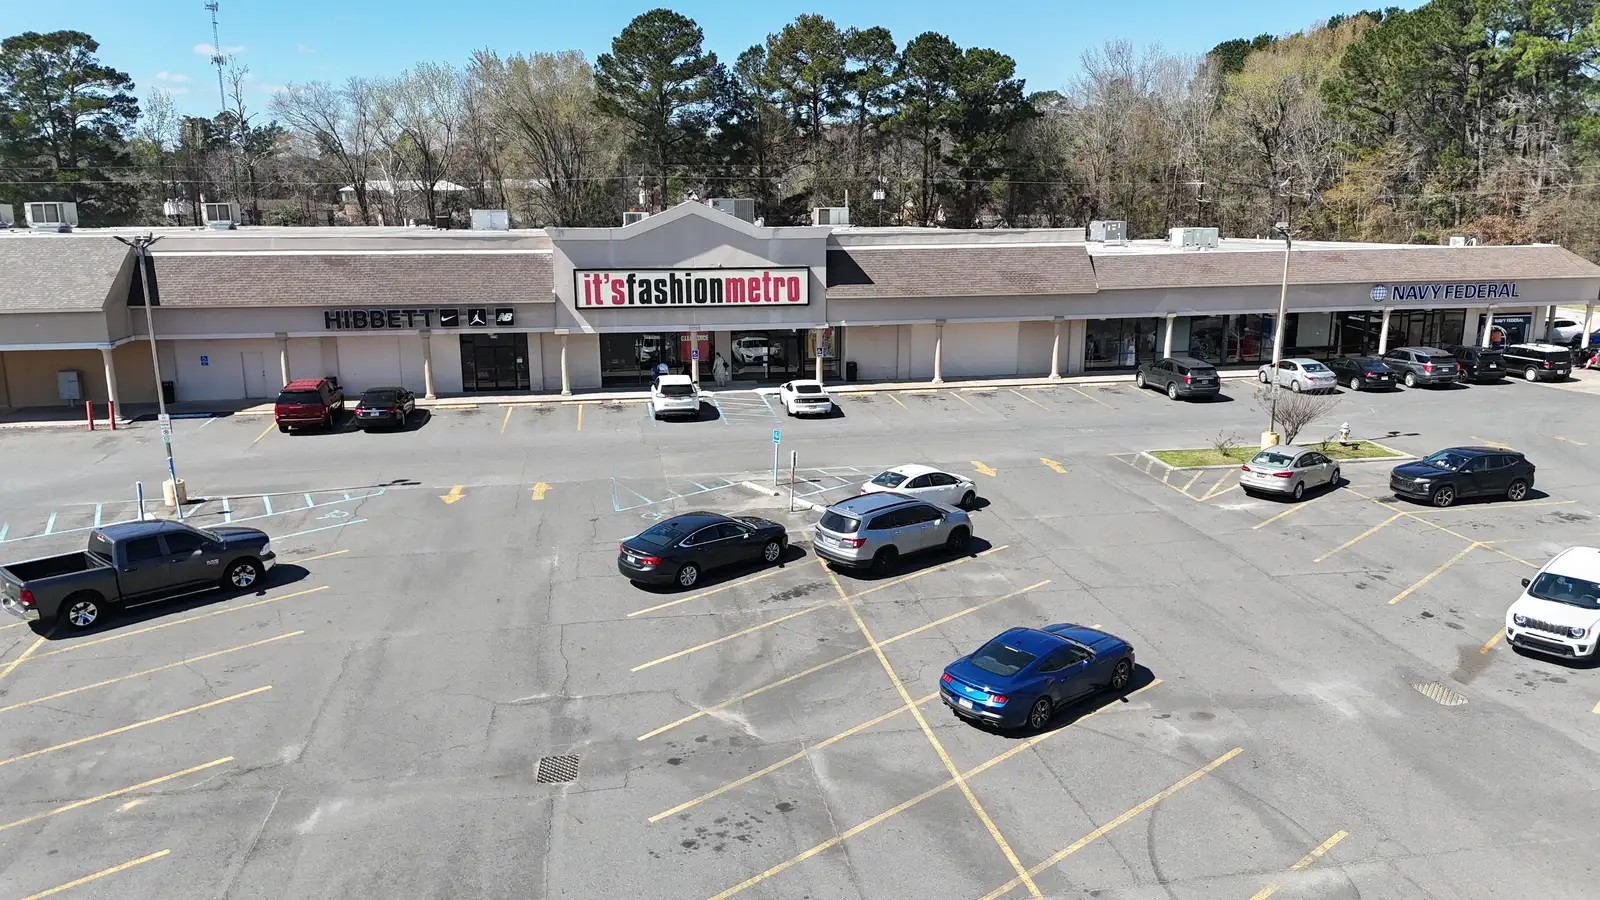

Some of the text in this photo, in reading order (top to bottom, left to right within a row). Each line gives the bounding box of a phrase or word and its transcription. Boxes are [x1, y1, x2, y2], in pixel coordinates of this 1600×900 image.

[1391, 282, 1520, 301] NAVY FEDERAL
[323, 308, 435, 330] HIBBETT
